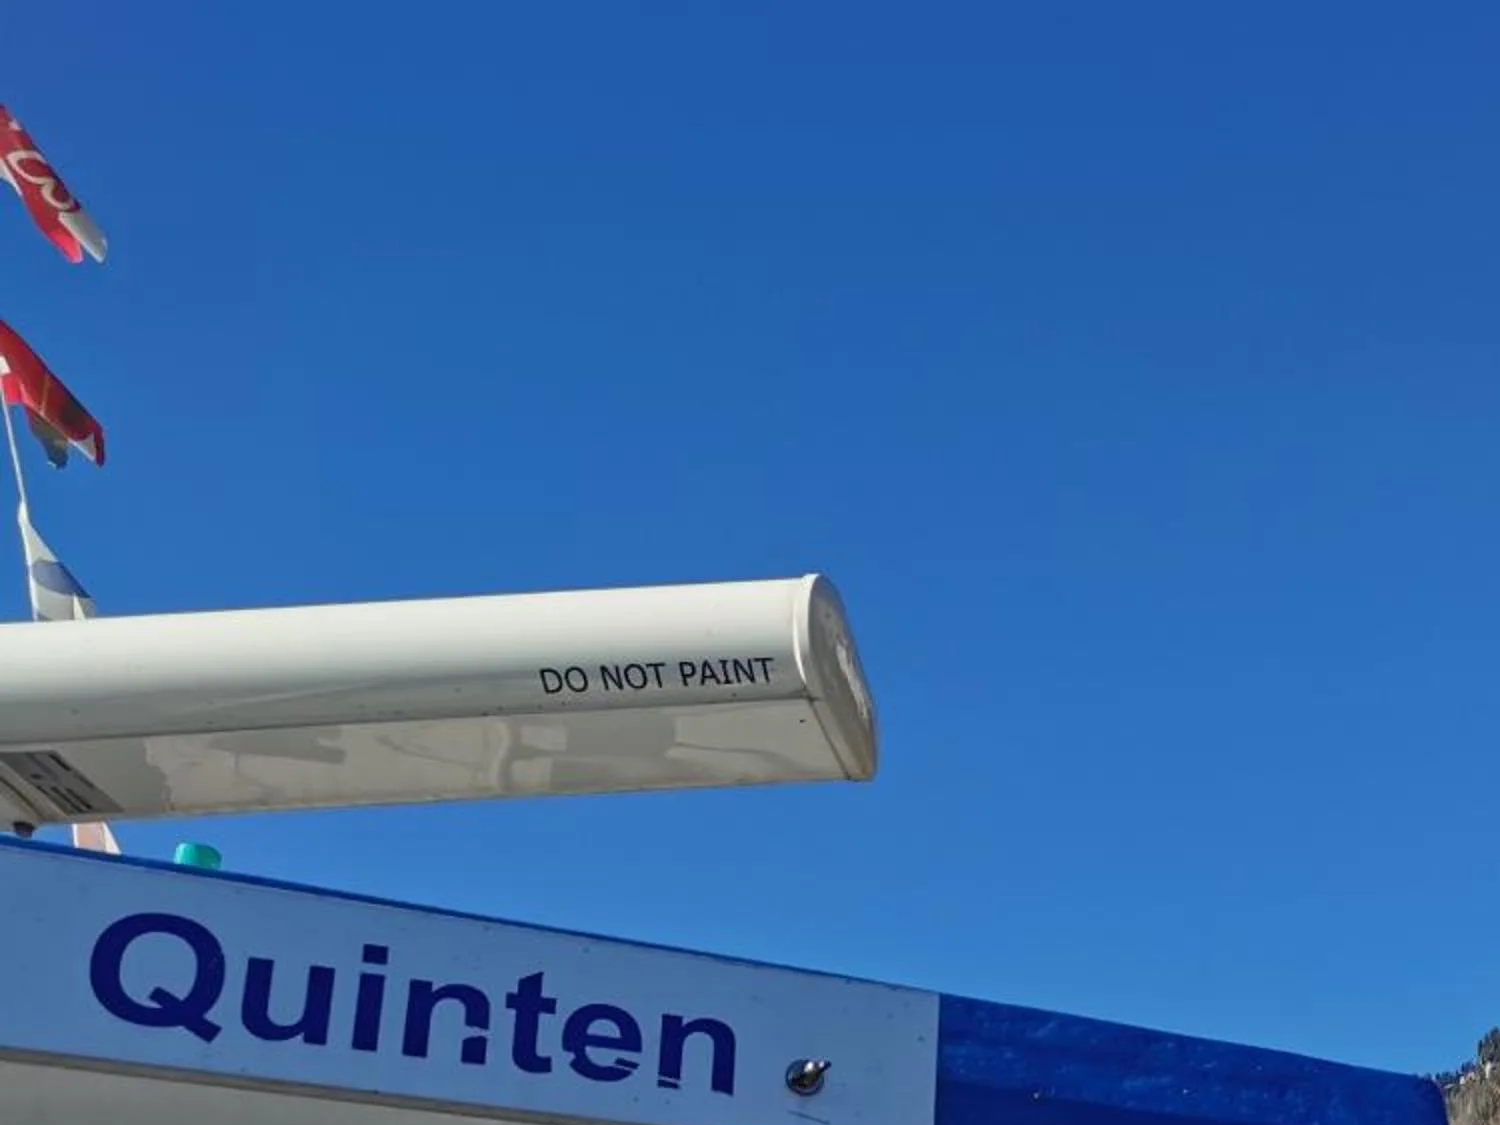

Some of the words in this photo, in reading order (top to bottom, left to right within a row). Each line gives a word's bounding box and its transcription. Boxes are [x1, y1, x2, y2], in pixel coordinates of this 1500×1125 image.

[539, 666, 589, 694] DO
[600, 662, 666, 691] NOT
[678, 657, 774, 687] PAINT
[89, 912, 738, 1097] Quinten
